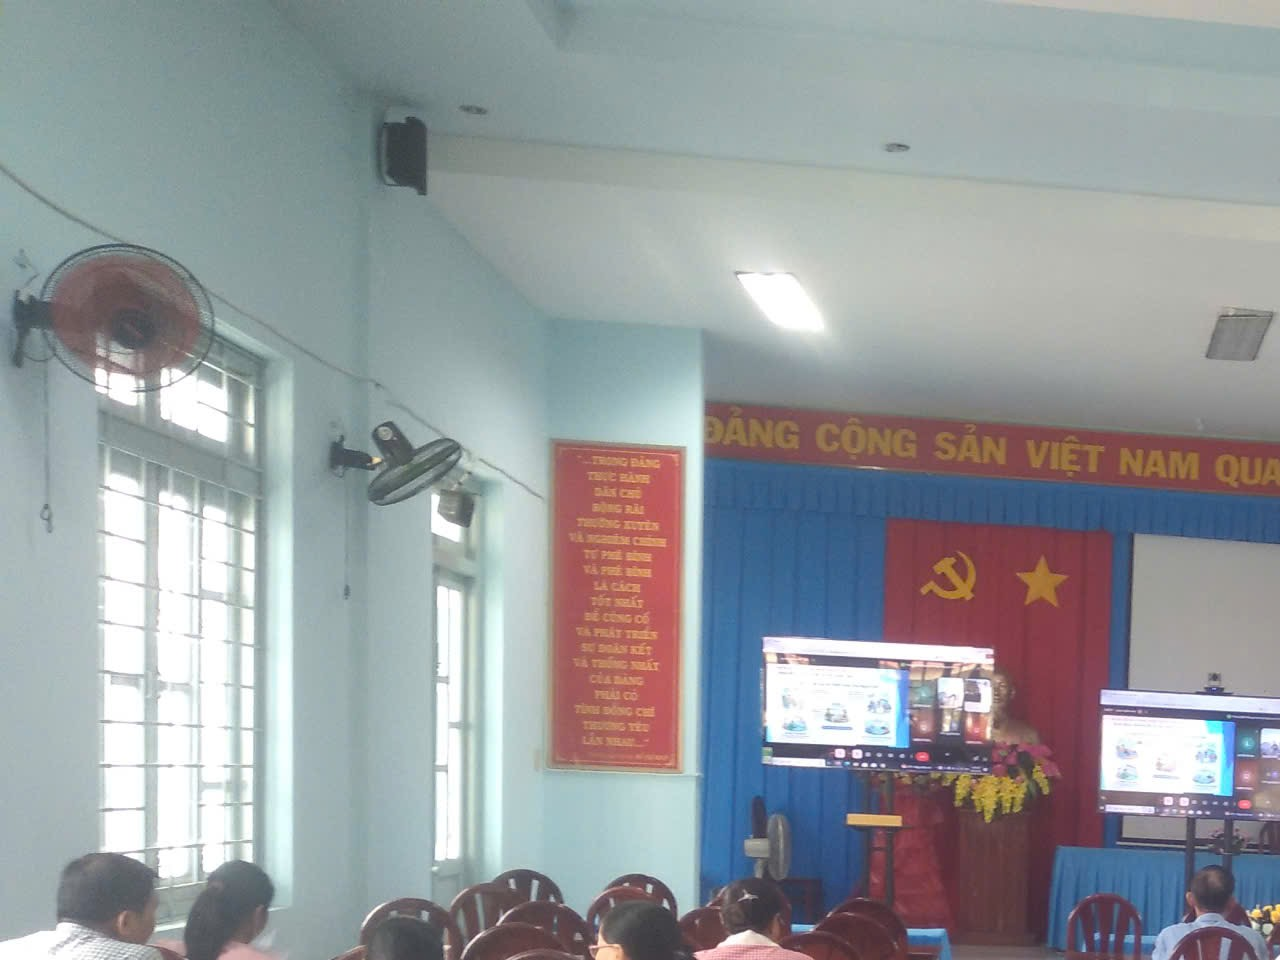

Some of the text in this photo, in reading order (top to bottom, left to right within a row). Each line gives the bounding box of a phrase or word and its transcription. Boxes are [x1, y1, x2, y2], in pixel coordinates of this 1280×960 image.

[703, 407, 799, 449] ĐẢNG
[815, 418, 918, 461] CỘNG
[933, 423, 1006, 465] SẢN
[1026, 435, 1105, 478] VIỆT
[1120, 447, 1199, 480] NAM
